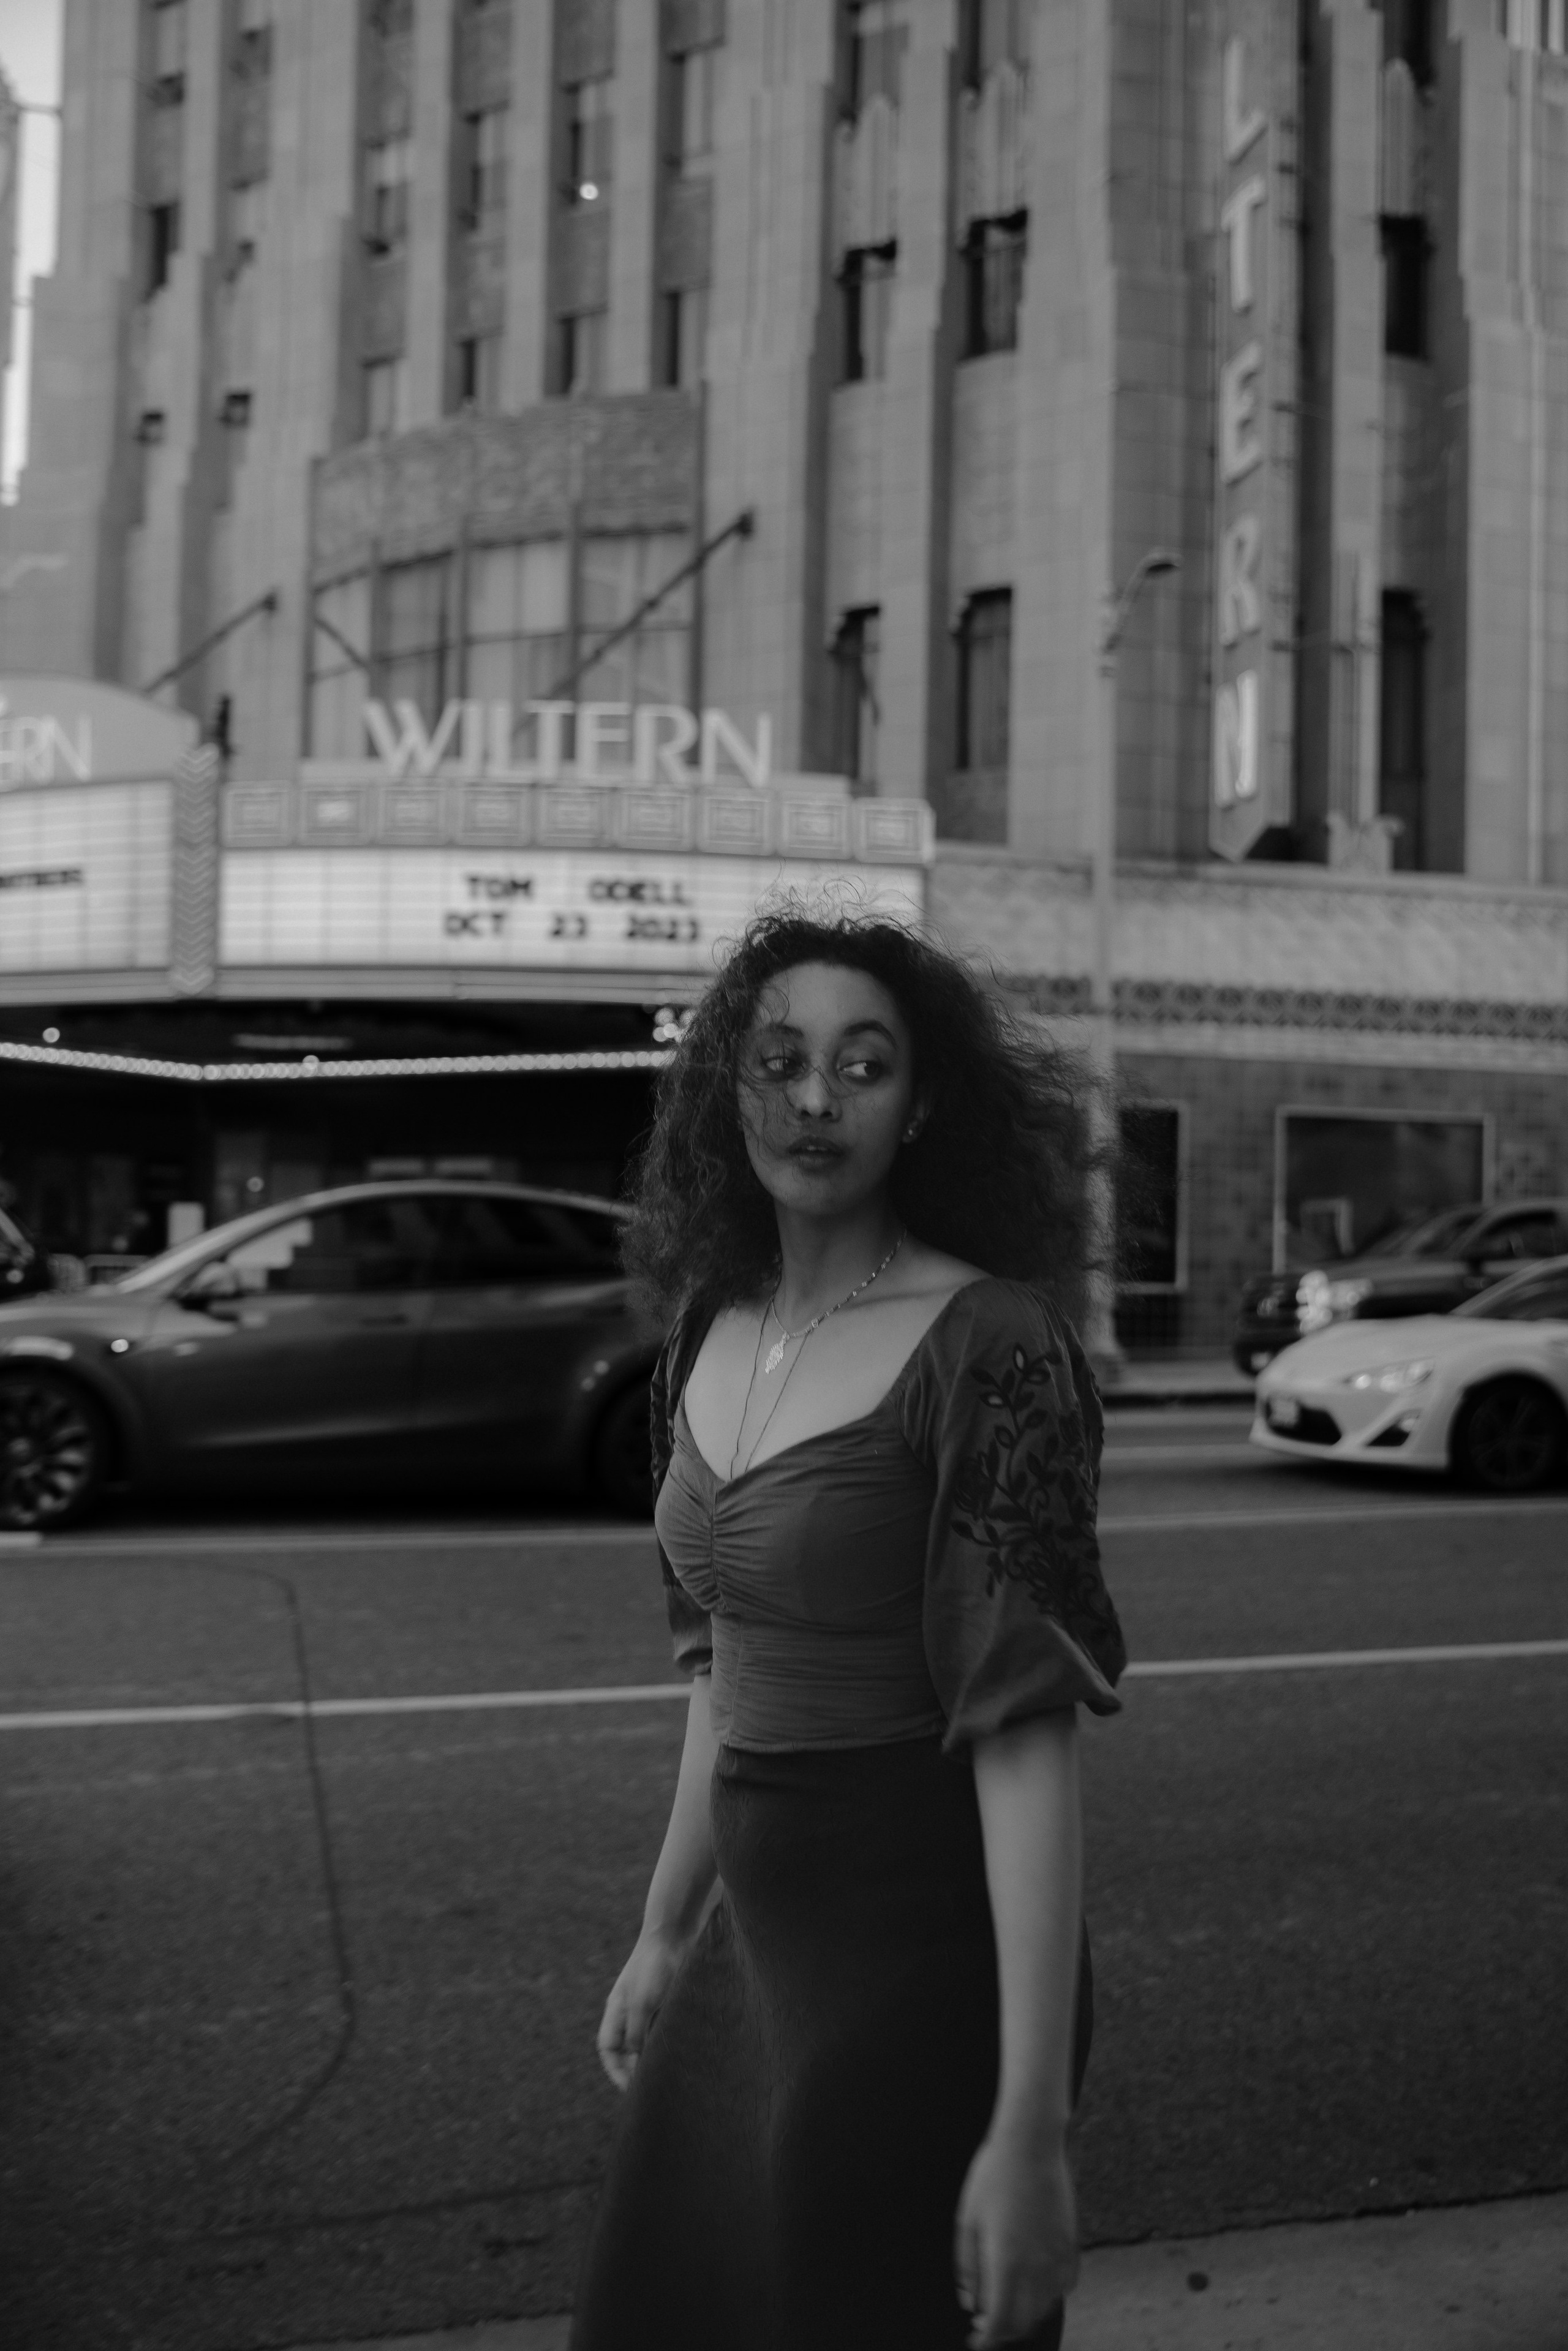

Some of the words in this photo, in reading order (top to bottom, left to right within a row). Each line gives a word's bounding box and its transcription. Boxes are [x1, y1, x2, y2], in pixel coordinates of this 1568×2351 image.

[365, 697, 772, 790] WILTERN
[466, 875, 533, 900] TOM
[445, 912, 505, 937] OCT
